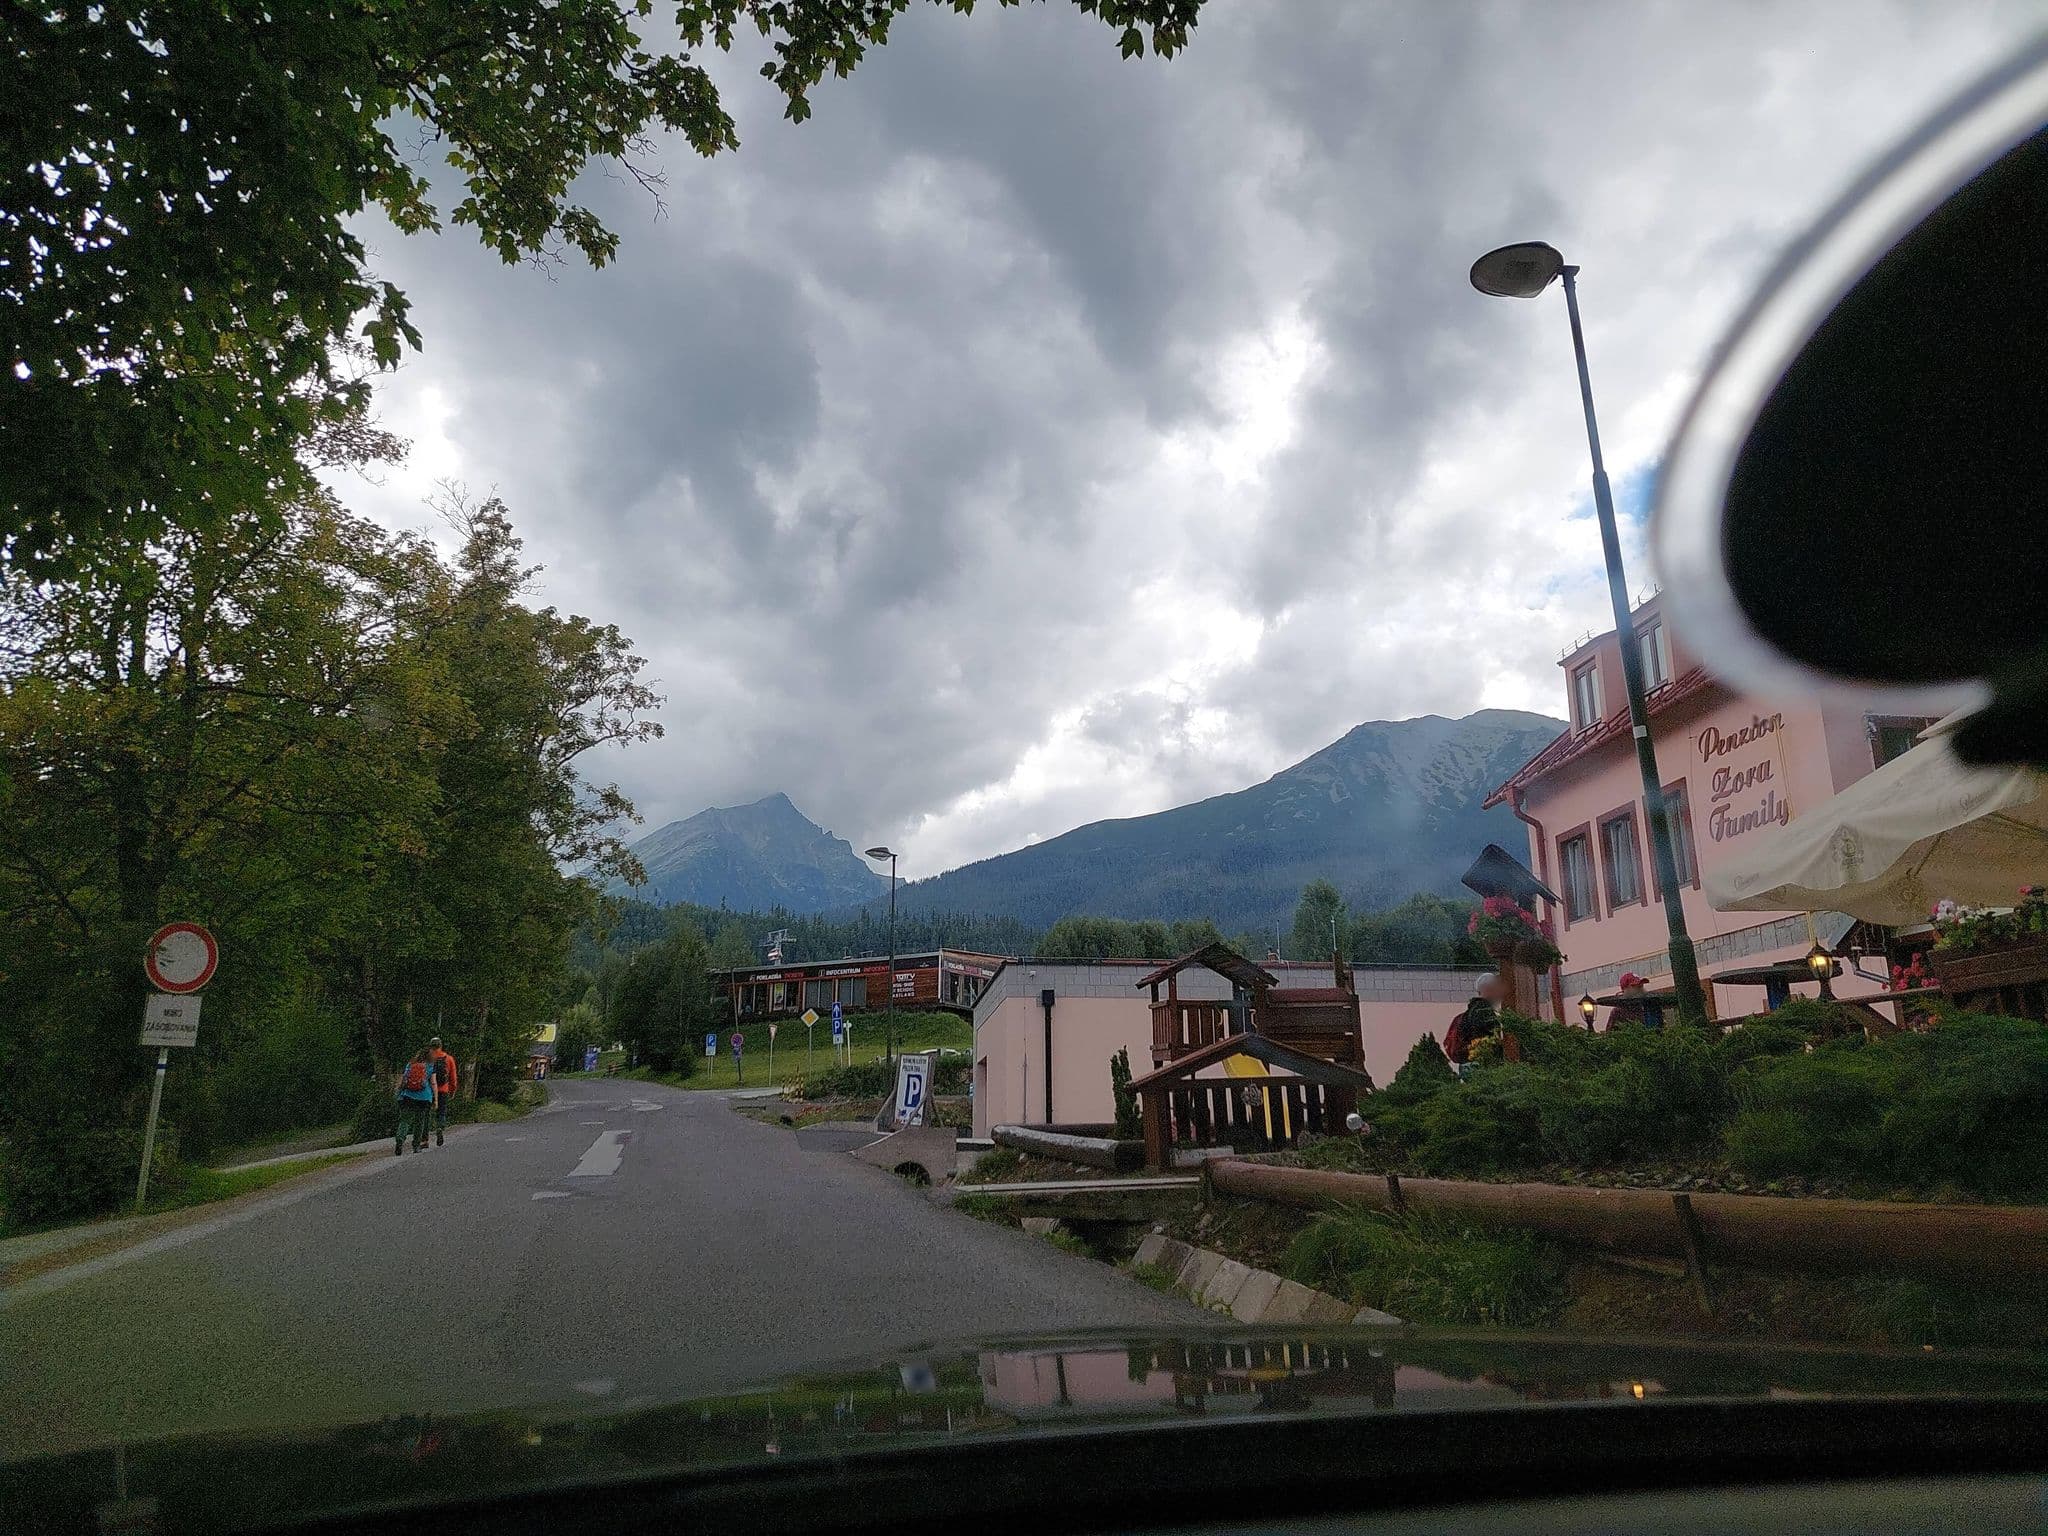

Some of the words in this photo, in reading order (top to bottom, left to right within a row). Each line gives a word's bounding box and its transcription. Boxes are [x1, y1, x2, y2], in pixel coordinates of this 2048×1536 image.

[1698, 712, 1785, 763] Penzion
[1711, 760, 1775, 802] Zora
[1709, 790, 1789, 842] Family
[825, 967, 861, 976] INFOCENTRUM
[907, 1076, 920, 1105] P
